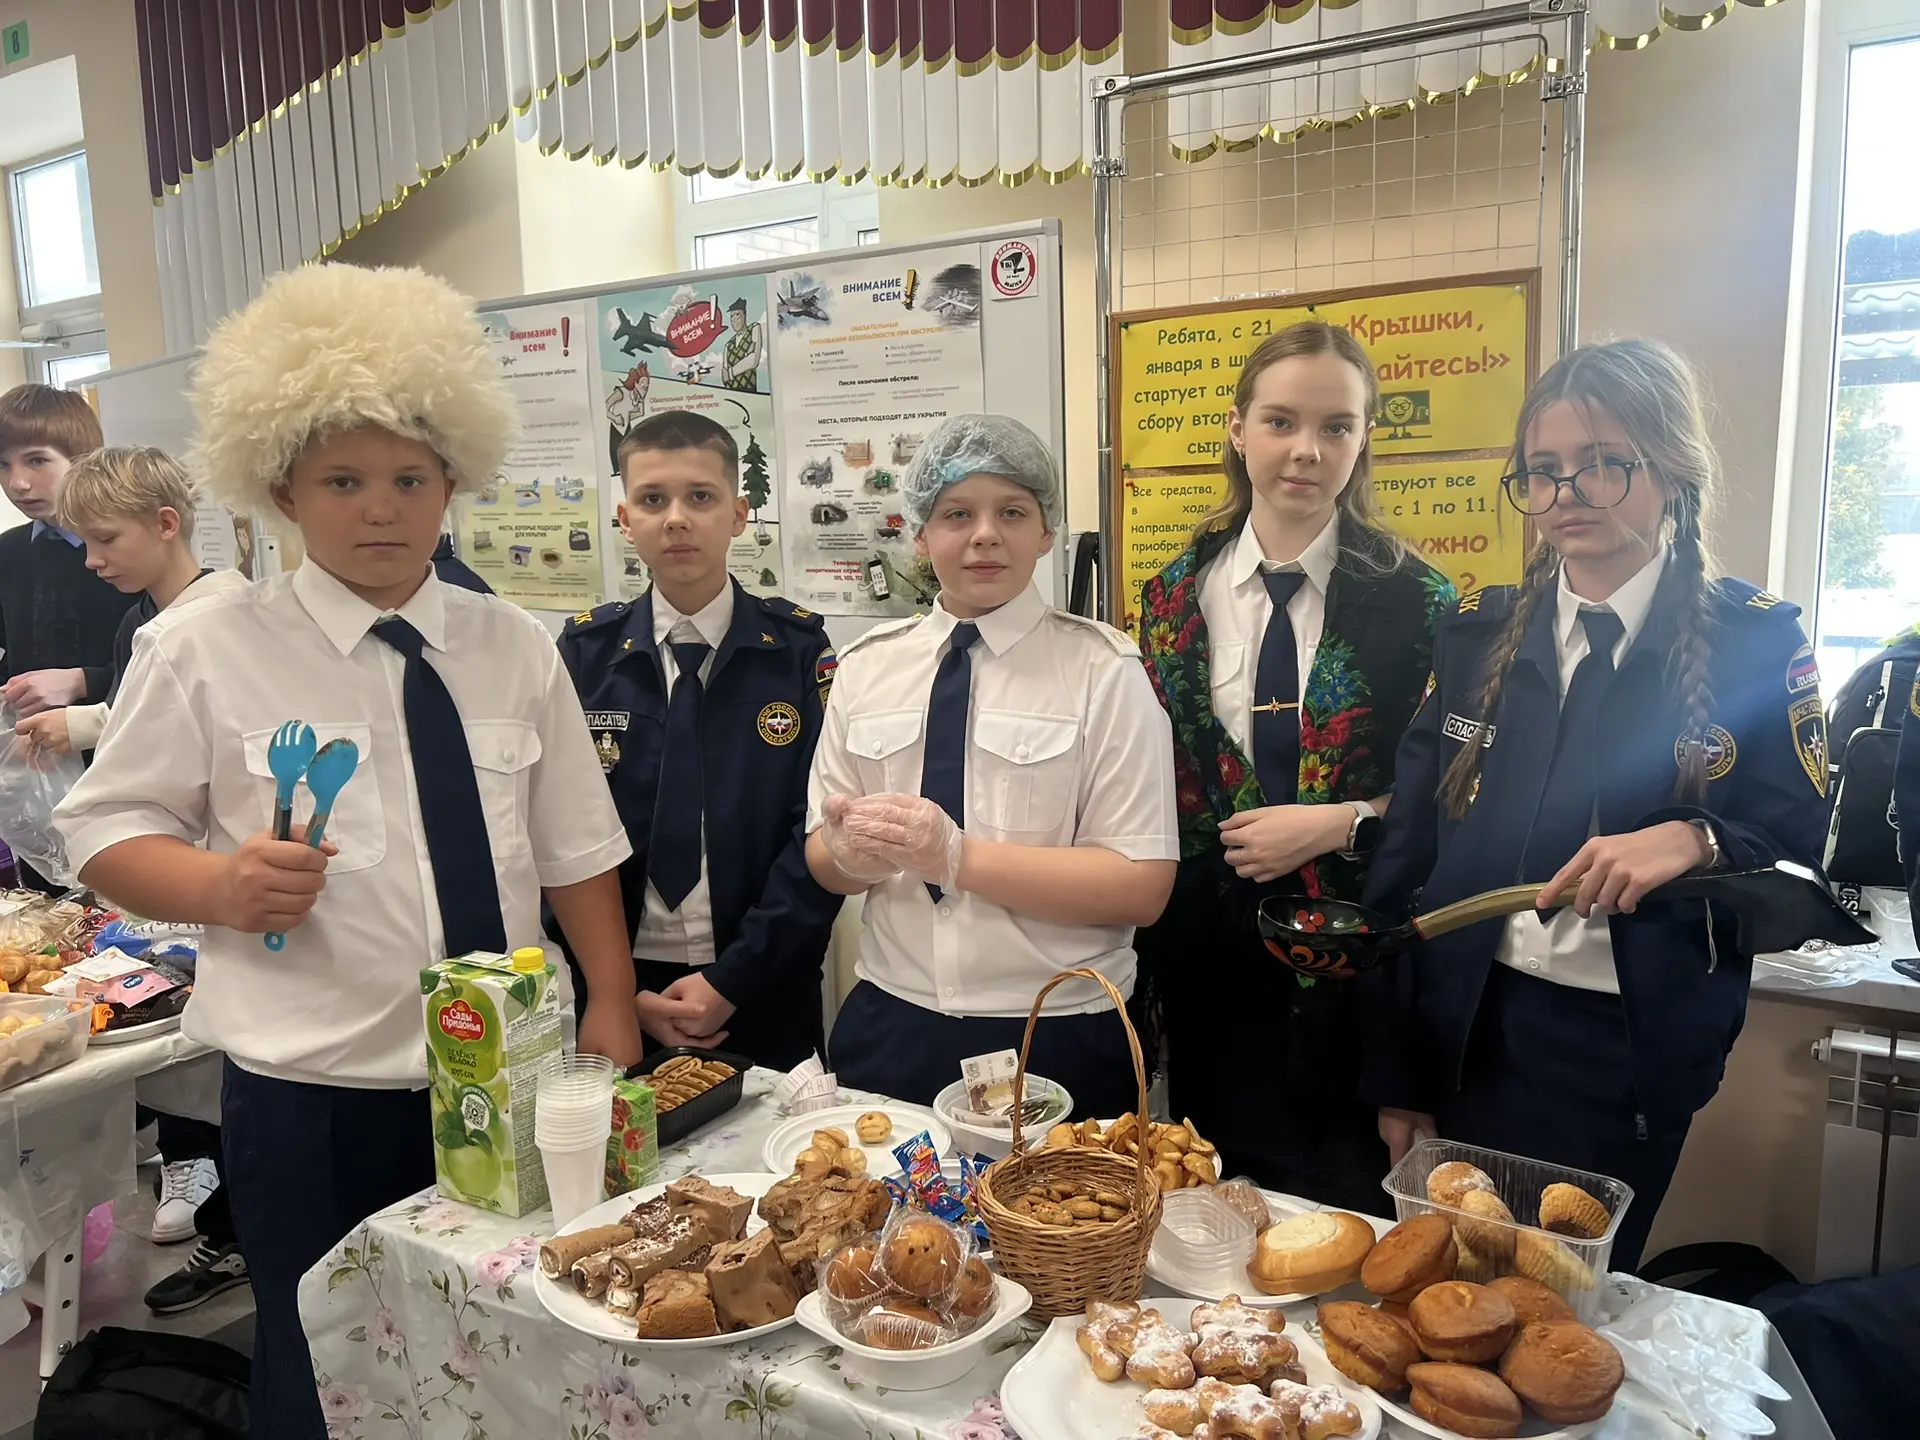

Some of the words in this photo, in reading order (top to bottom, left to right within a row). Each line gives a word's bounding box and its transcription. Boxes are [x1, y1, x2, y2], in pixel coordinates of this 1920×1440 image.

[12, 29, 20, 55] 8
[842, 277, 901, 294] ВНИМАНИЕ
[872, 291, 901, 303] ВСЕМ
[670, 310, 711, 340] ВНИМАНИЕ
[1158, 327, 1222, 346] Ребята,
[1232, 326, 1242, 339] с
[1251, 319, 1273, 337] 21
[1345, 310, 1484, 346] Крышки,
[509, 327, 557, 341] Внимание
[683, 329, 704, 344] ВСЕМ
[522, 342, 546, 353] всем
[1145, 358, 1202, 376] января
[1211, 357, 1220, 369] в
[1376, 346, 1511, 382] айтесь!»
[857, 377, 889, 385] окончания
[1134, 385, 1207, 406] стартует
[1215, 383, 1236, 397] ак
[840, 415, 868, 423] КОТОРЫЕ
[869, 413, 902, 422] ПОДХОДЯТ
[903, 412, 916, 420] ДЛЯ
[917, 411, 947, 419] УКРЫТИЯ
[1137, 413, 1184, 433] сбору
[1192, 412, 1229, 429] втор
[1132, 486, 1152, 497] Все
[1160, 485, 1217, 498] средства,
[1373, 477, 1437, 494] ствуют
[1445, 475, 1476, 487] все
[1132, 507, 1138, 515] в
[1393, 505, 1403, 516] с
[1412, 500, 1421, 515] 1
[1432, 502, 1456, 514] по
[1131, 540, 1186, 554] приобрет
[1131, 558, 1167, 569] необх
[1132, 579, 1144, 590] ср
[587, 713, 627, 726] ПАСАТЕЛЬ
[760, 708, 771, 722] МЧС
[771, 704, 797, 720] РОССИИ
[761, 726, 798, 743] СПАСАТЕЛЬ
[1678, 734, 1690, 749] МЧ
[1705, 727, 1733, 748] ССИИ
[450, 1008, 473, 1022] Сады
[442, 1015, 481, 1032] Придонья
